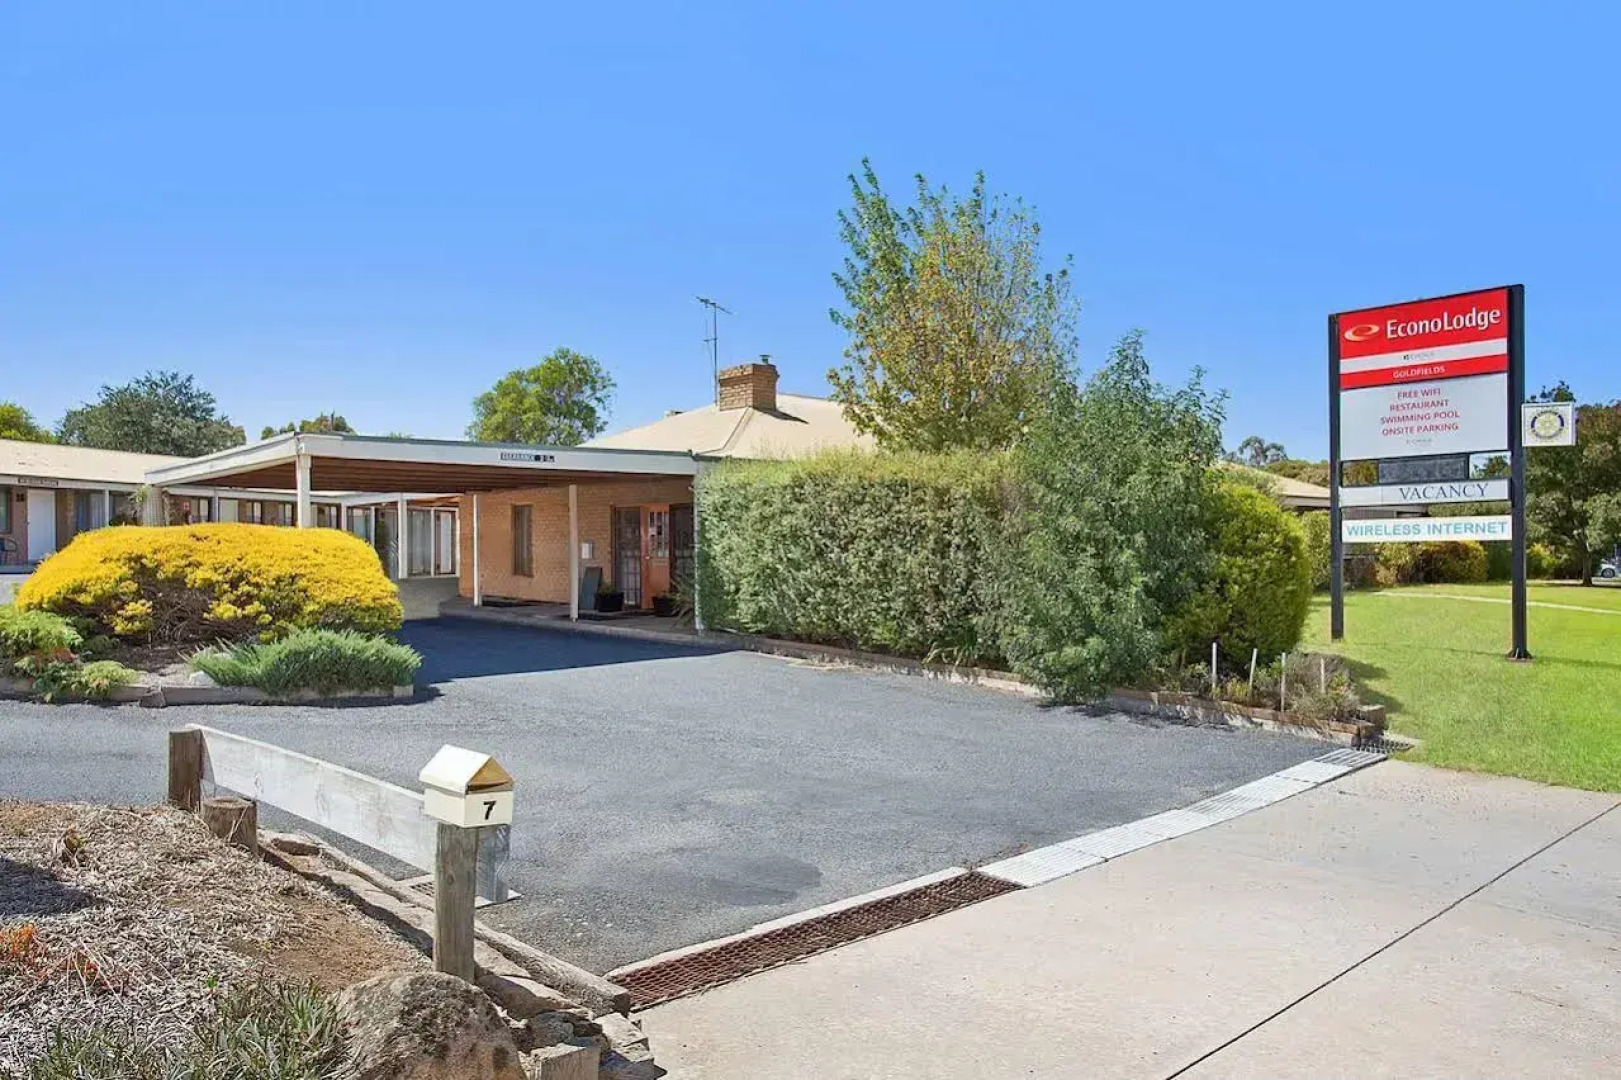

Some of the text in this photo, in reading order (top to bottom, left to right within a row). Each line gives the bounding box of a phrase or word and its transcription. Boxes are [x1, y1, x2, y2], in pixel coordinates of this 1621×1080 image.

[1386, 307, 1501, 339] EconoLodge
[1393, 366, 1446, 379] GOLDFIELDS
[1397, 388, 1441, 400] FREE WIFI
[1390, 399, 1450, 412] RESTAURANT
[1380, 410, 1460, 425] SWIMMING POOL
[1382, 423, 1459, 437] ONSITE PARKING
[1399, 483, 1489, 500] VACANCY
[1346, 521, 1508, 537] WIRELESS INTERNET
[483, 800, 497, 820] 7
